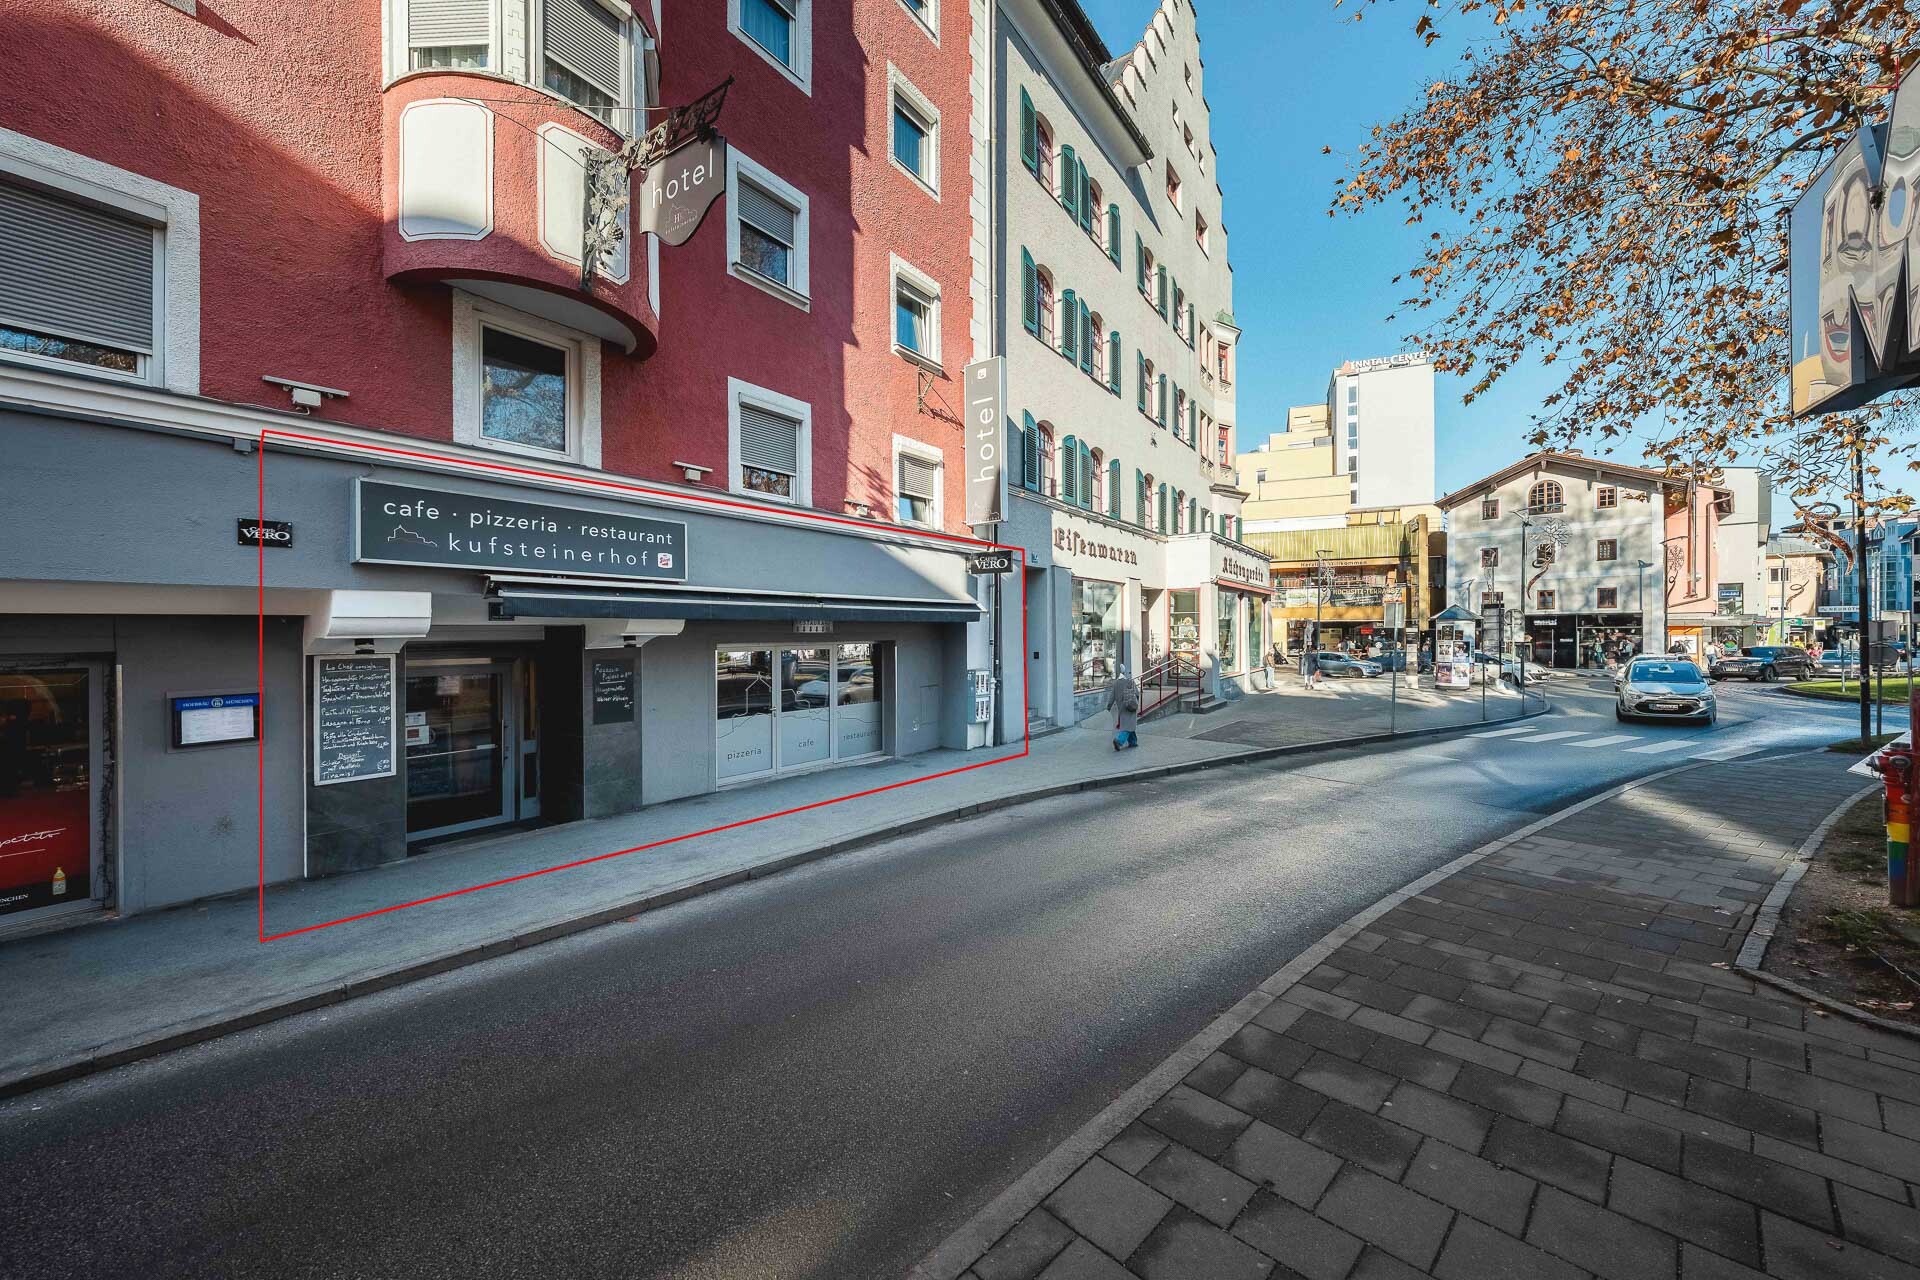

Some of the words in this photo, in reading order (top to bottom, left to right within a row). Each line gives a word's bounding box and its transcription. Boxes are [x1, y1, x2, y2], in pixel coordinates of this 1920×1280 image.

[652, 148, 713, 209] hotel
[973, 396, 994, 482] hotel
[240, 528, 290, 540] VERO
[383, 500, 440, 519] cafe
[470, 509, 557, 533] pizzeria
[581, 523, 673, 545] restaurant
[449, 532, 649, 566] kufsteinerhof
[975, 559, 1008, 569] VERO
[727, 747, 762, 760] pizzeria
[798, 738, 814, 748] cafe
